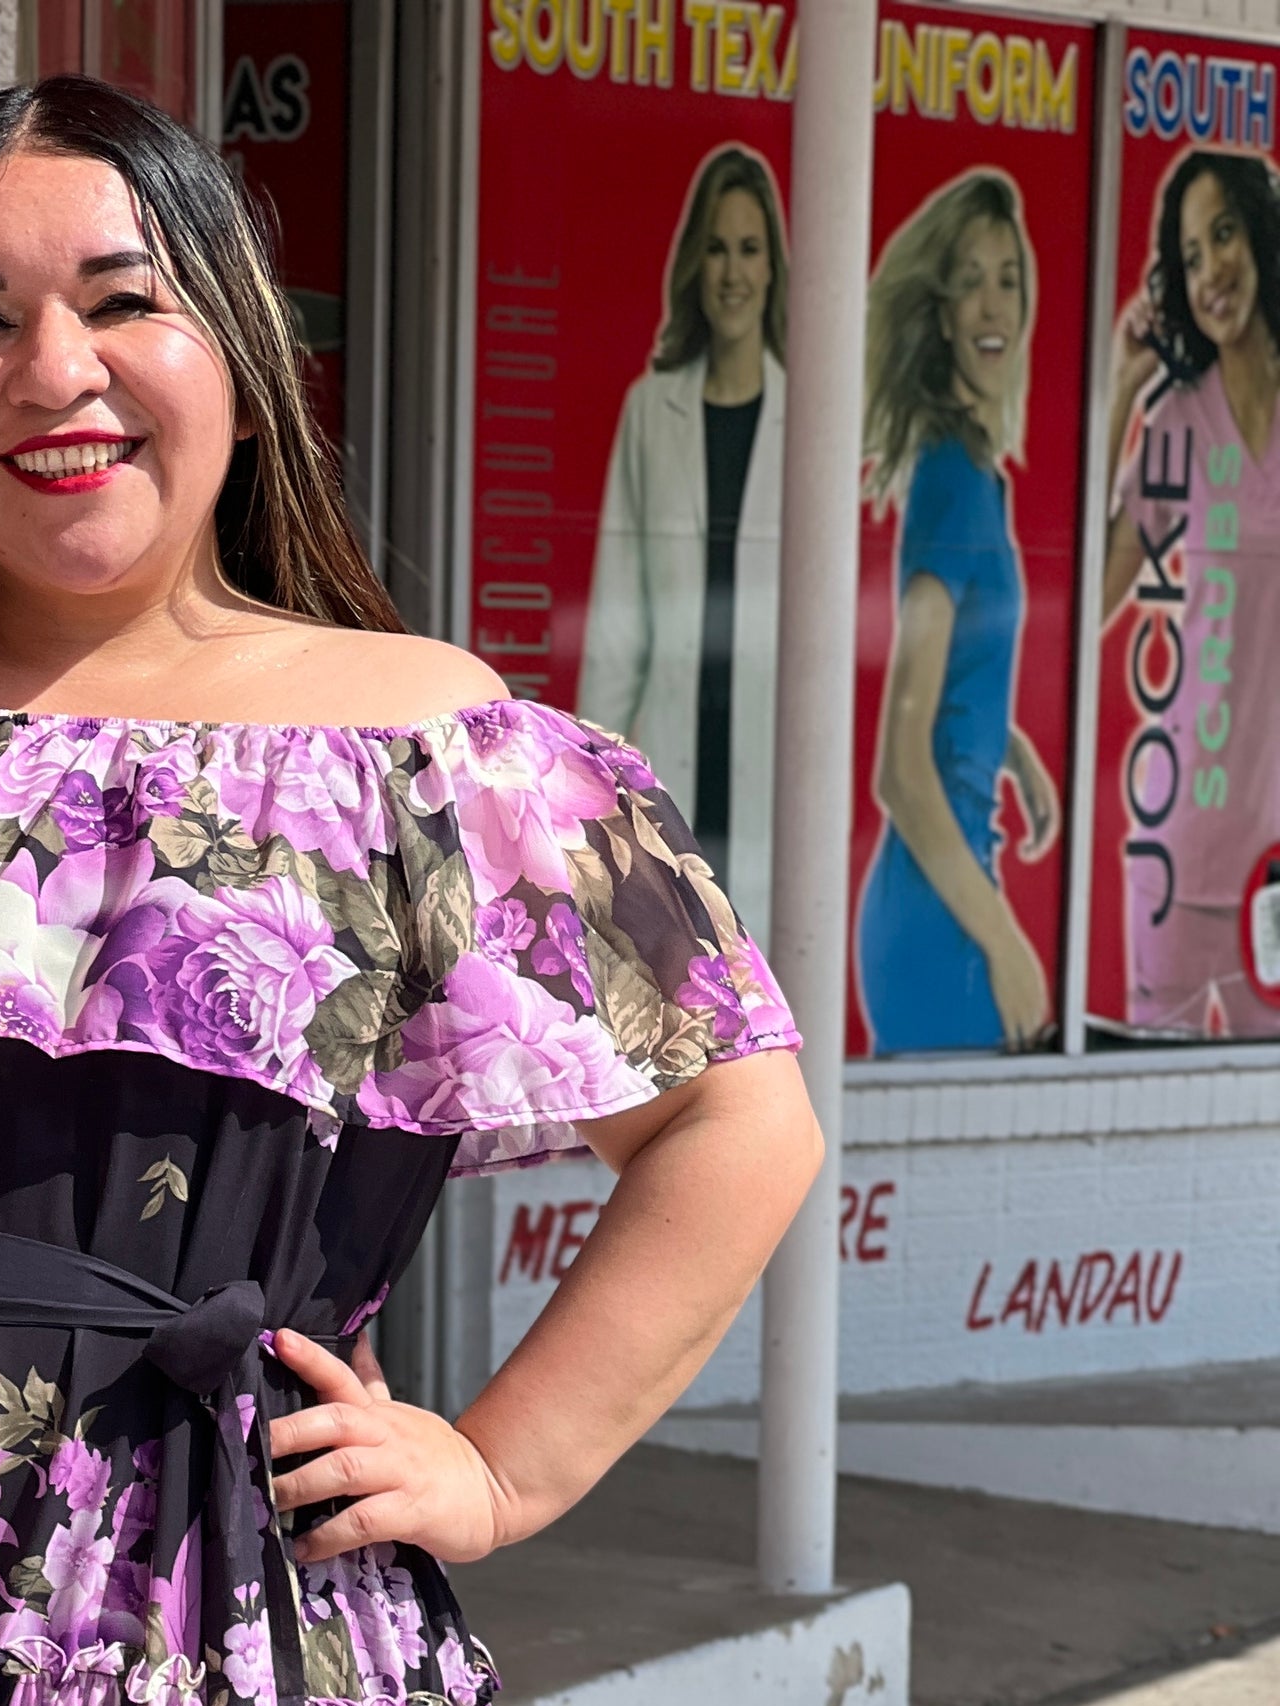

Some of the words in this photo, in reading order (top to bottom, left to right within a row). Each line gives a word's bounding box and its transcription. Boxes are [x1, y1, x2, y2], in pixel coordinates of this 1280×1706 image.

[489, 0, 674, 89] SOUTH
[1125, 47, 1276, 149] SOUTH
[1193, 442, 1243, 809] SCRUBS
[499, 1201, 608, 1285] ME
[966, 1249, 1182, 1334] LANDAU
